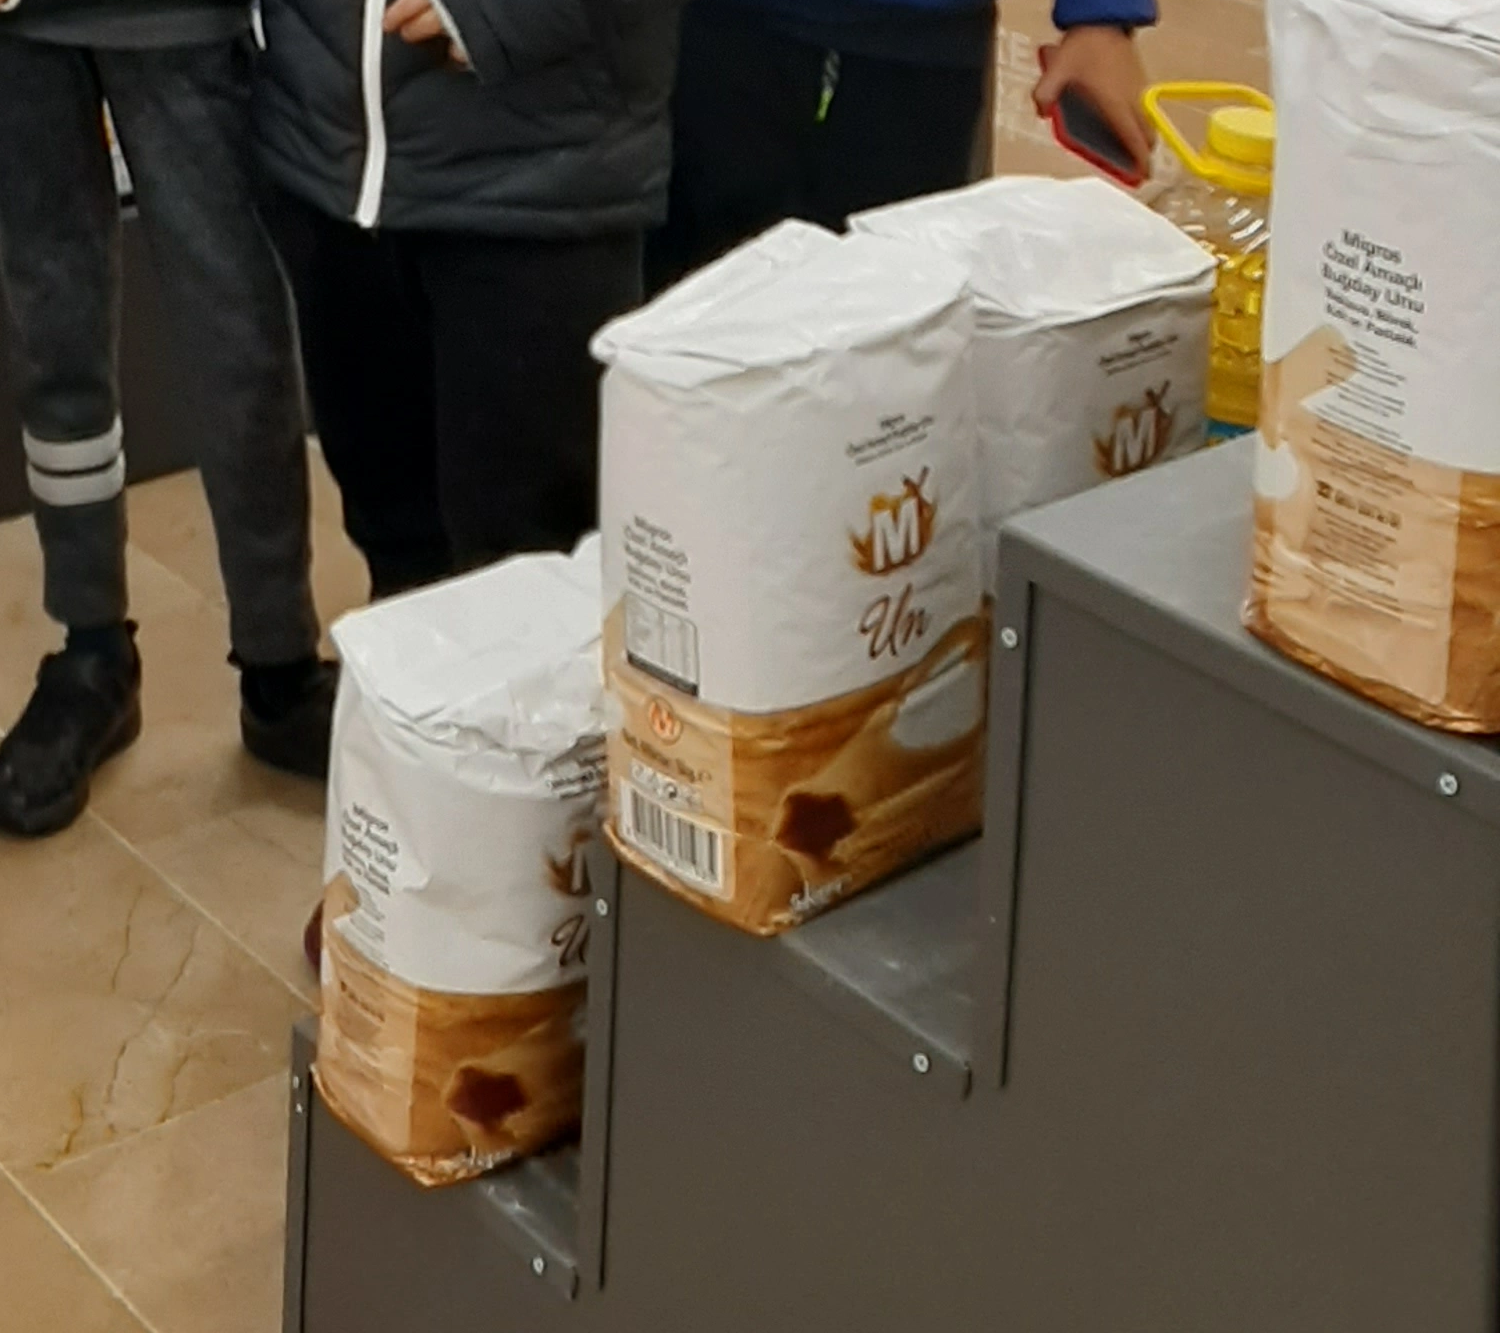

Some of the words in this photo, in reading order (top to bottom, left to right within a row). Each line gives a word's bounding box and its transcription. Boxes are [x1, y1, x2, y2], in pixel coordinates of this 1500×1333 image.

[1344, 230, 1402, 264] Migros
[1385, 289, 1425, 313] Unu
[858, 582, 932, 661] Un
